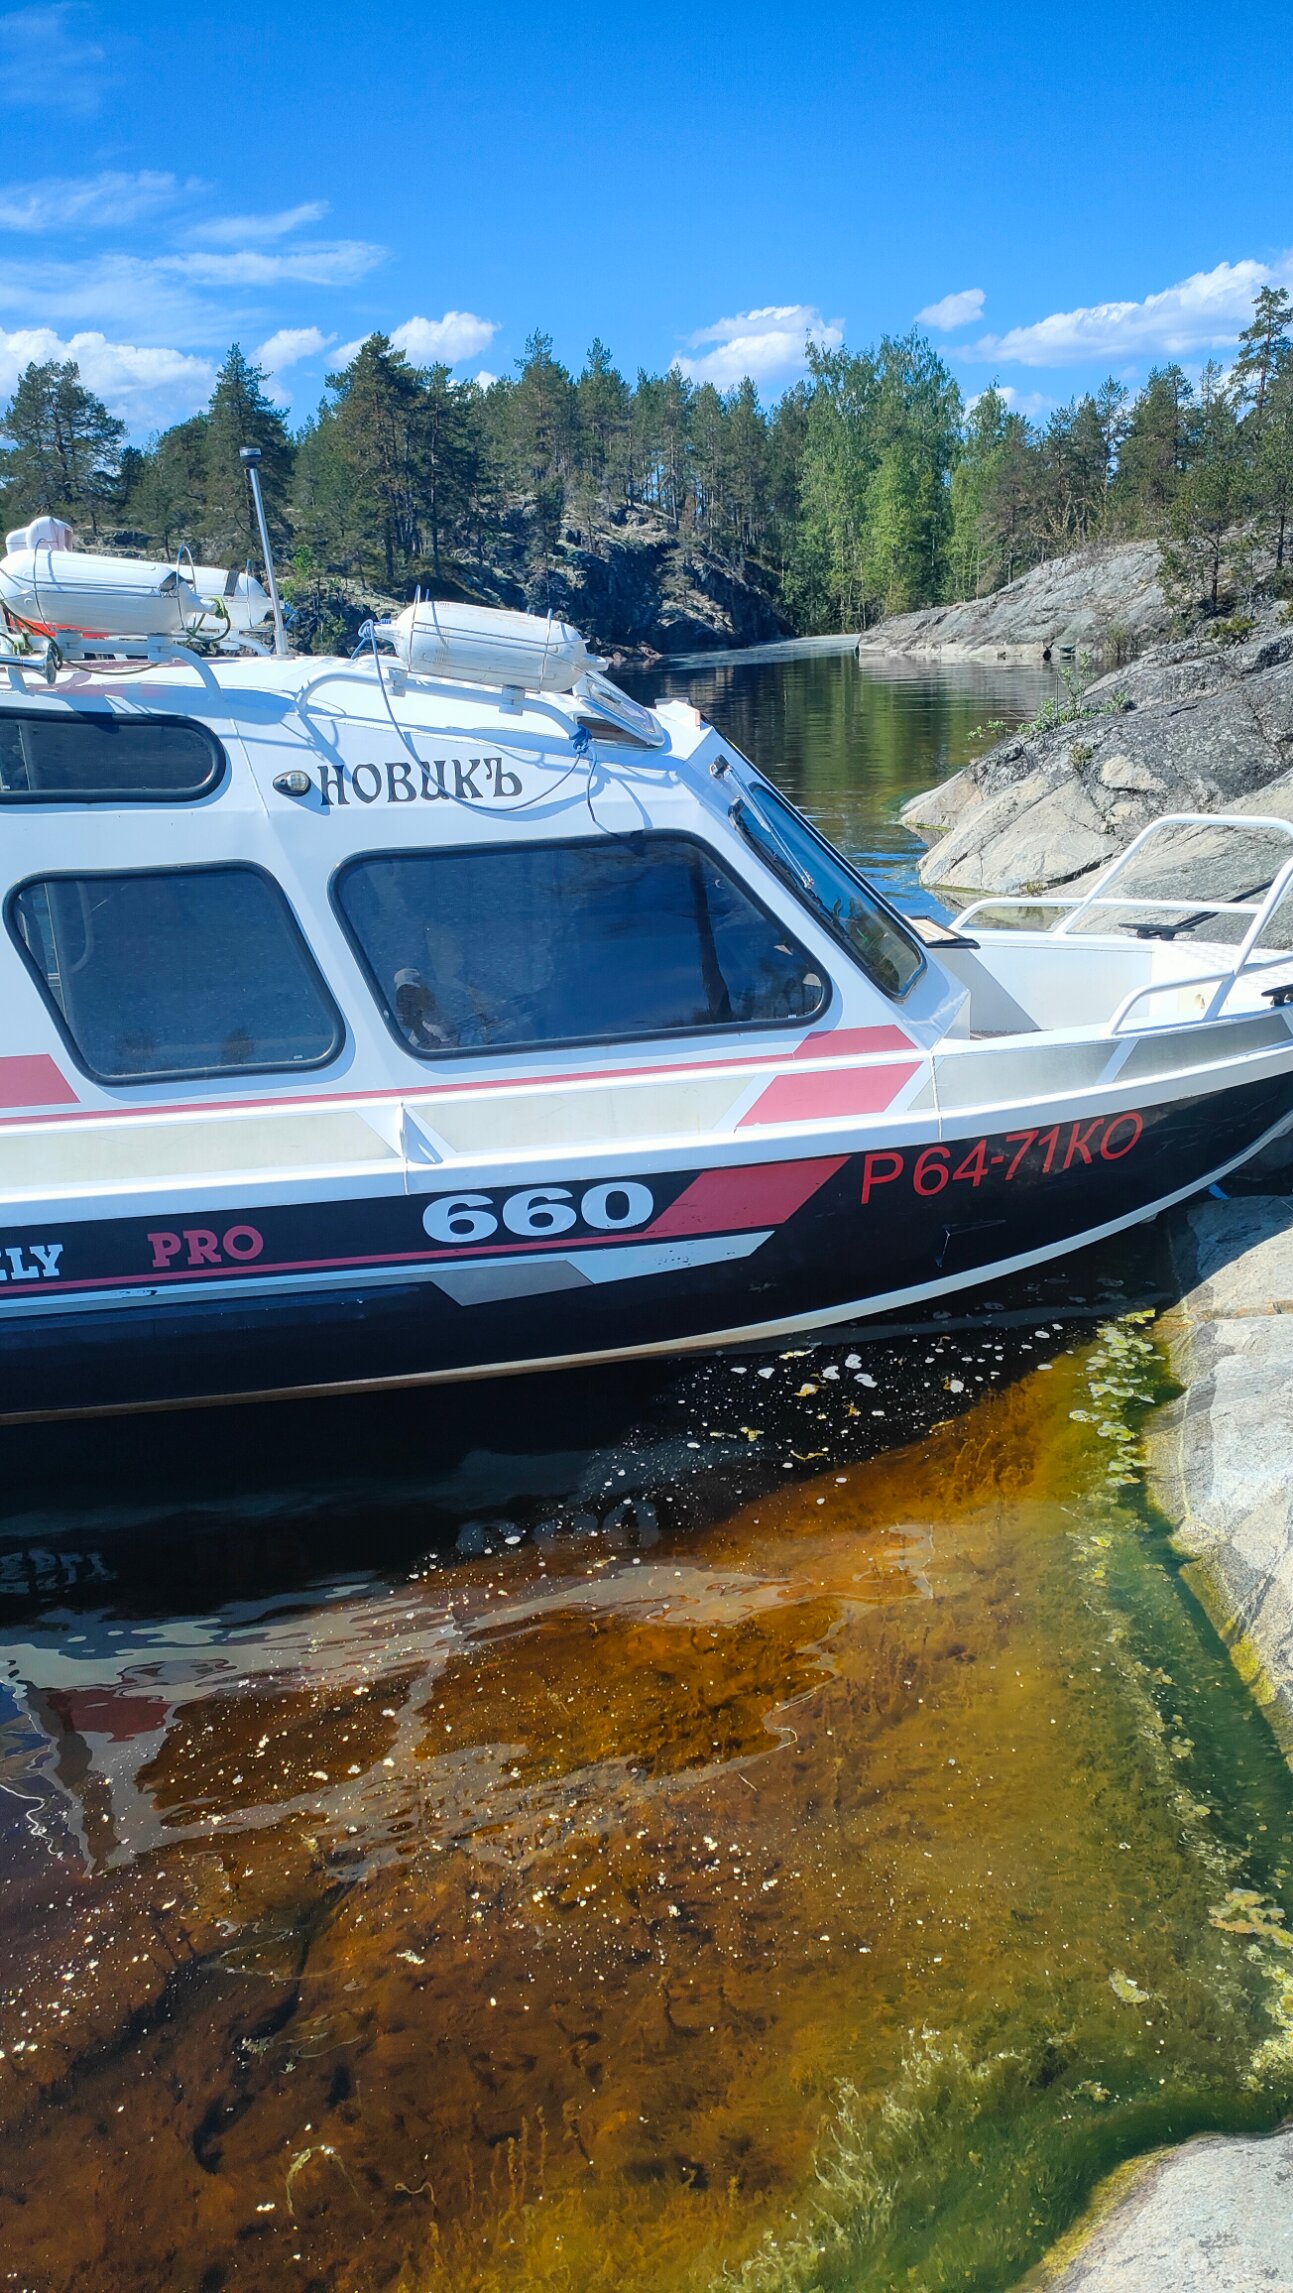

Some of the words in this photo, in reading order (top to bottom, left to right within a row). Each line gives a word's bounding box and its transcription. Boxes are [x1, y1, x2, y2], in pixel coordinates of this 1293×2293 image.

[317, 757, 523, 806] НОВИКЪ
[0, 1244, 64, 1281] LY
[147, 1225, 264, 1268] PRO
[422, 1181, 655, 1244] 660
